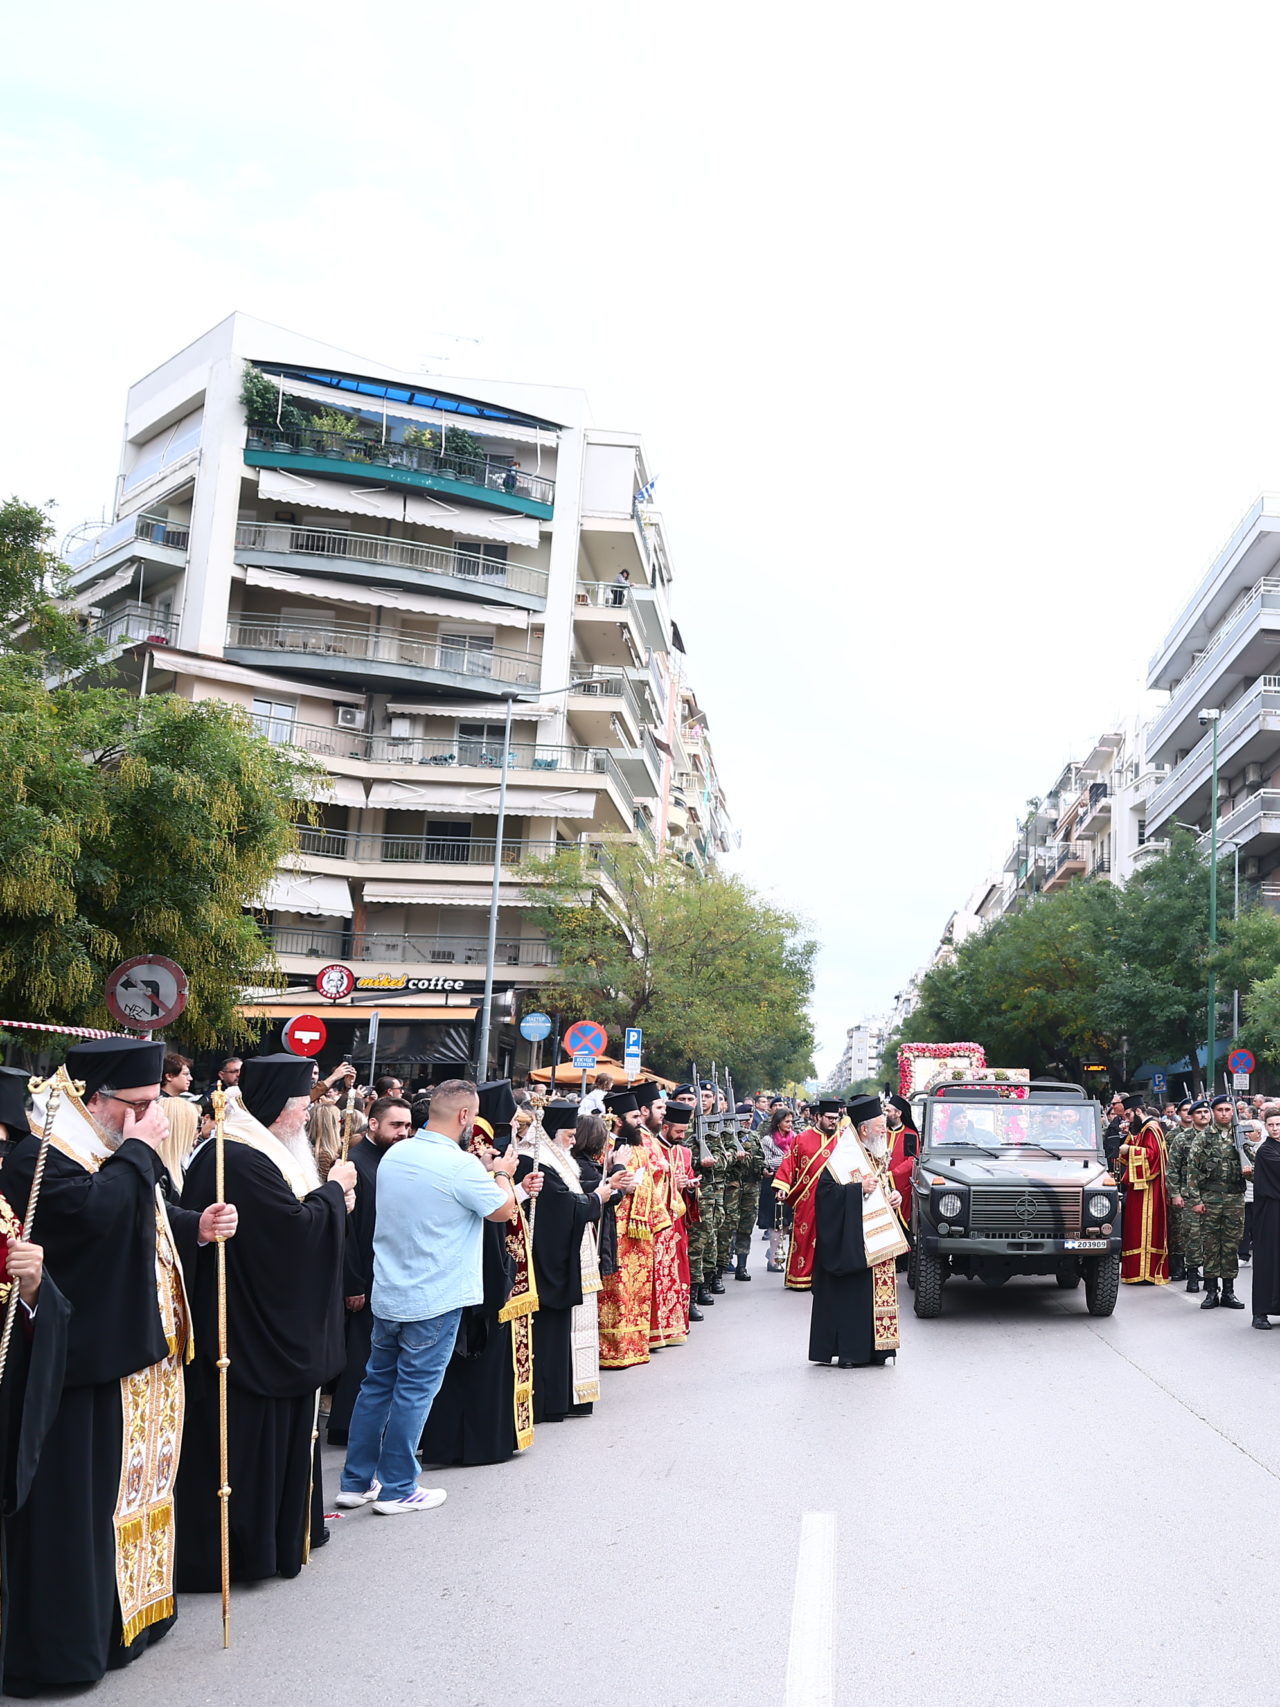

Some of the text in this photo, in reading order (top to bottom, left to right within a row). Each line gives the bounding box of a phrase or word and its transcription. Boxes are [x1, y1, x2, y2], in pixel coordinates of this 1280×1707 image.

[408, 976, 464, 990] coffee
[629, 1031, 638, 1045] P
[1154, 1074, 1163, 1084] P
